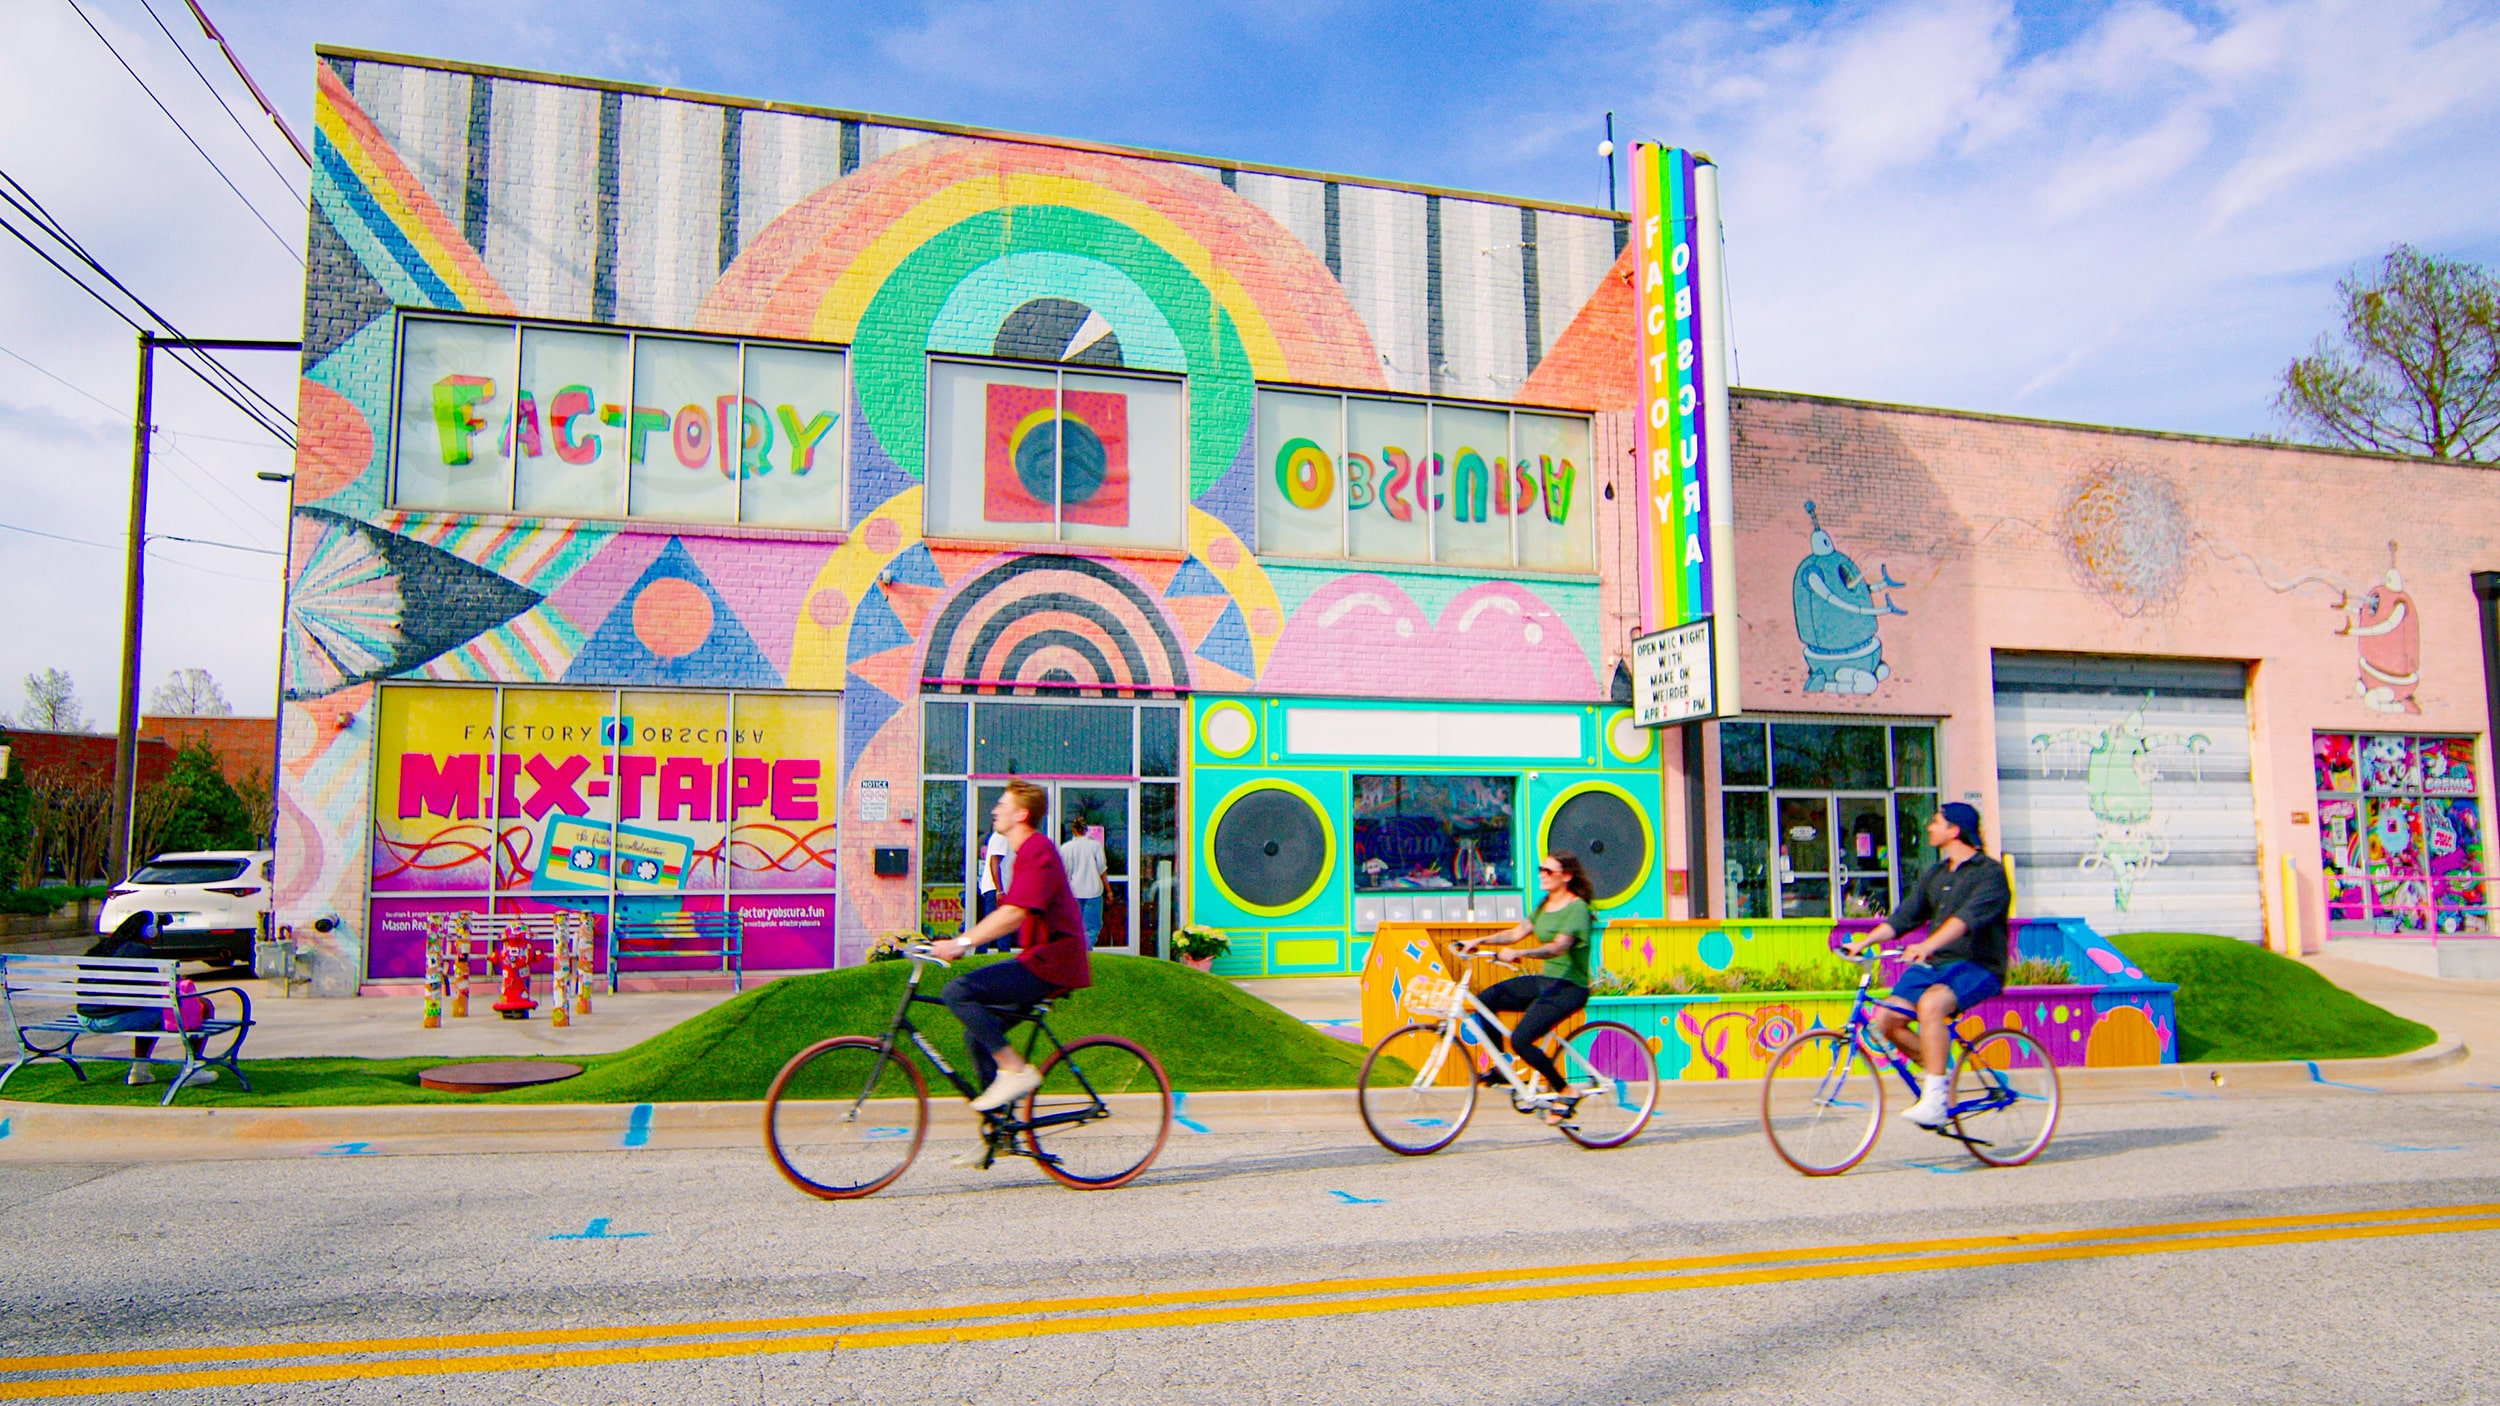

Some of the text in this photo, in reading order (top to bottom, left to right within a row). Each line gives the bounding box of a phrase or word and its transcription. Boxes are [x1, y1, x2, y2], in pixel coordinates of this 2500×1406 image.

[1645, 214, 1673, 523] FACTORY
[1671, 242, 1704, 567] OBSCURA
[432, 374, 841, 480] FACTORY
[1637, 629, 1705, 657] OPEN MIC NIGHT
[1658, 652, 1683, 668] WITH
[1650, 667, 1691, 687] MAKE OK
[1652, 685, 1690, 703] WEIRDER
[1644, 698, 1706, 720] APR 2 7 PM
[464, 725, 764, 744] FACTORY OBSCURA
[398, 753, 821, 822] MIX-TAPE
[740, 905, 825, 920] factoryobscura.fun
[926, 909, 963, 922] TAPE
[382, 919, 410, 931] Mason
